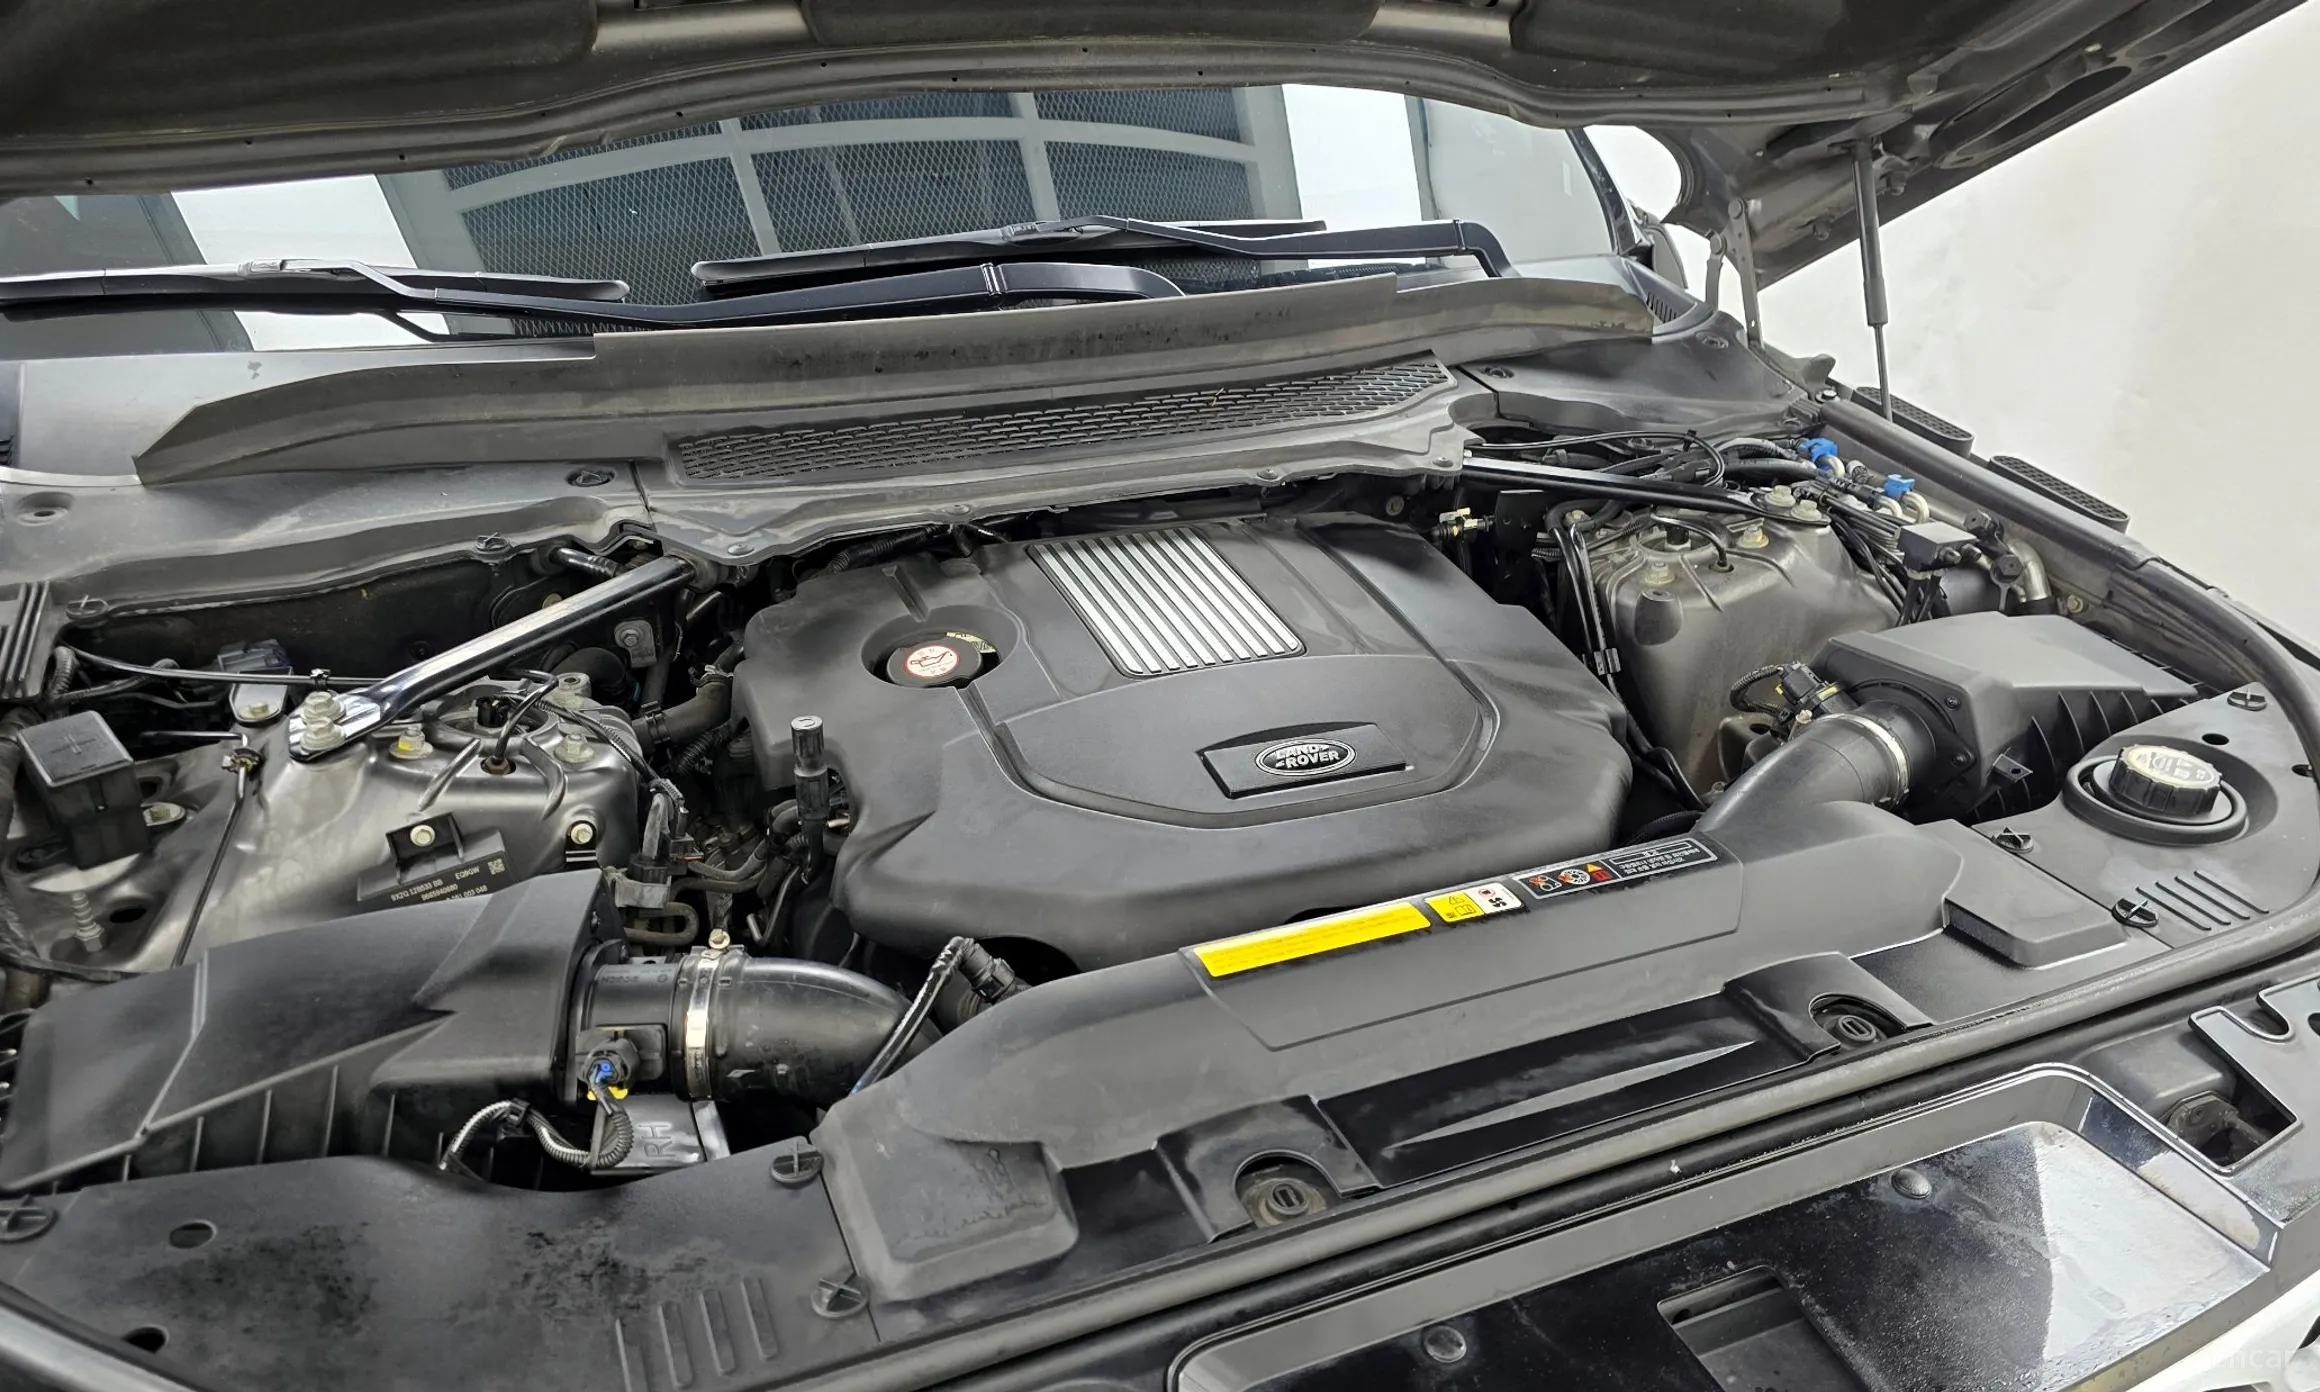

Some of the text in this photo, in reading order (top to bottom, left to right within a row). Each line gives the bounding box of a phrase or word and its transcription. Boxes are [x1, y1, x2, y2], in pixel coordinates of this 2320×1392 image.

[1275, 744, 1320, 759] LAND
[1285, 751, 1340, 769] ROVER
[638, 1123, 676, 1157] RH
